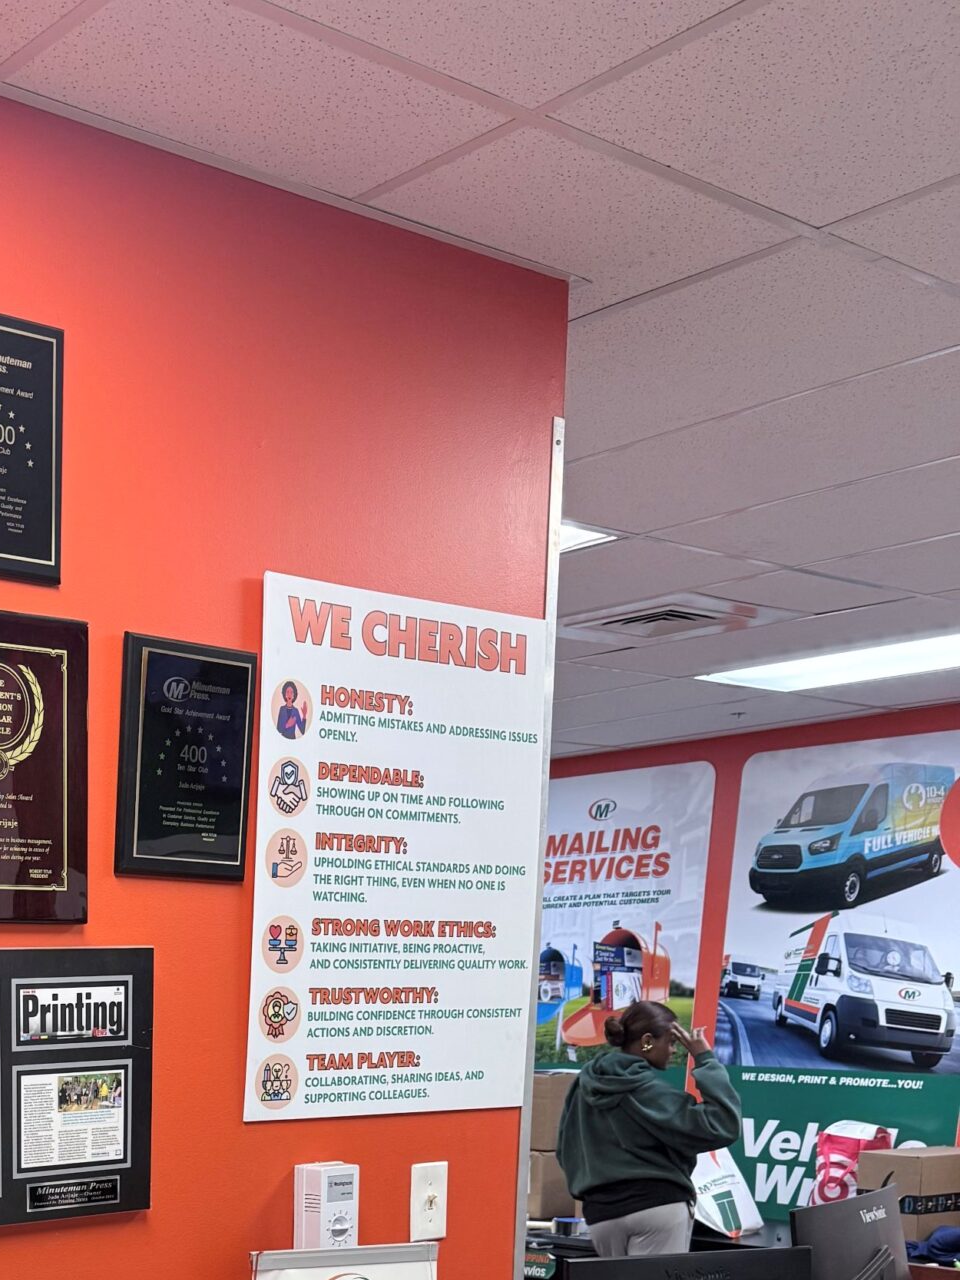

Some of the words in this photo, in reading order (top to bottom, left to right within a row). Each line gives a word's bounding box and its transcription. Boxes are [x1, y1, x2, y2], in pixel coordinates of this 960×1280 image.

[16, 387, 33, 399] Award
[288, 595, 352, 650] WE
[362, 610, 527, 675] CHERISH
[320, 684, 413, 716] HONESTY:
[319, 711, 376, 728] ADMITTING
[378, 718, 424, 733] MISTAKES
[426, 722, 446, 734] AND
[448, 724, 506, 741] ADDRESSING
[508, 731, 538, 744] ISSUES
[319, 728, 358, 742] OPENLY.
[180, 744, 207, 764] 400
[318, 762, 424, 788] DEPENDABLE:
[316, 786, 365, 801] SHOWING
[368, 791, 380, 802] UP
[382, 792, 398, 804] ON
[400, 793, 424, 805] TIME
[426, 795, 446, 807] AND
[448, 796, 504, 811] FOLLOWING
[315, 832, 408, 855] INTEGRITY:
[545, 825, 661, 858] MAILING
[864, 835, 893, 854] FULL
[896, 827, 930, 845] VEHICLE
[542, 852, 671, 885] SERVICES
[312, 918, 380, 936] STRONG
[384, 920, 434, 938] WORK
[438, 921, 497, 938] ETHICS:
[309, 987, 439, 1006] TRUSTWORTHY:
[23, 992, 122, 1035] Printing
[306, 1053, 354, 1071] TEAM
[357, 1050, 420, 1069] PLAYER:
[742, 1073, 756, 1082] WE
[758, 1074, 795, 1085] DESIGN,
[798, 1075, 826, 1085] PRINT
[829, 1077, 837, 1085] &
